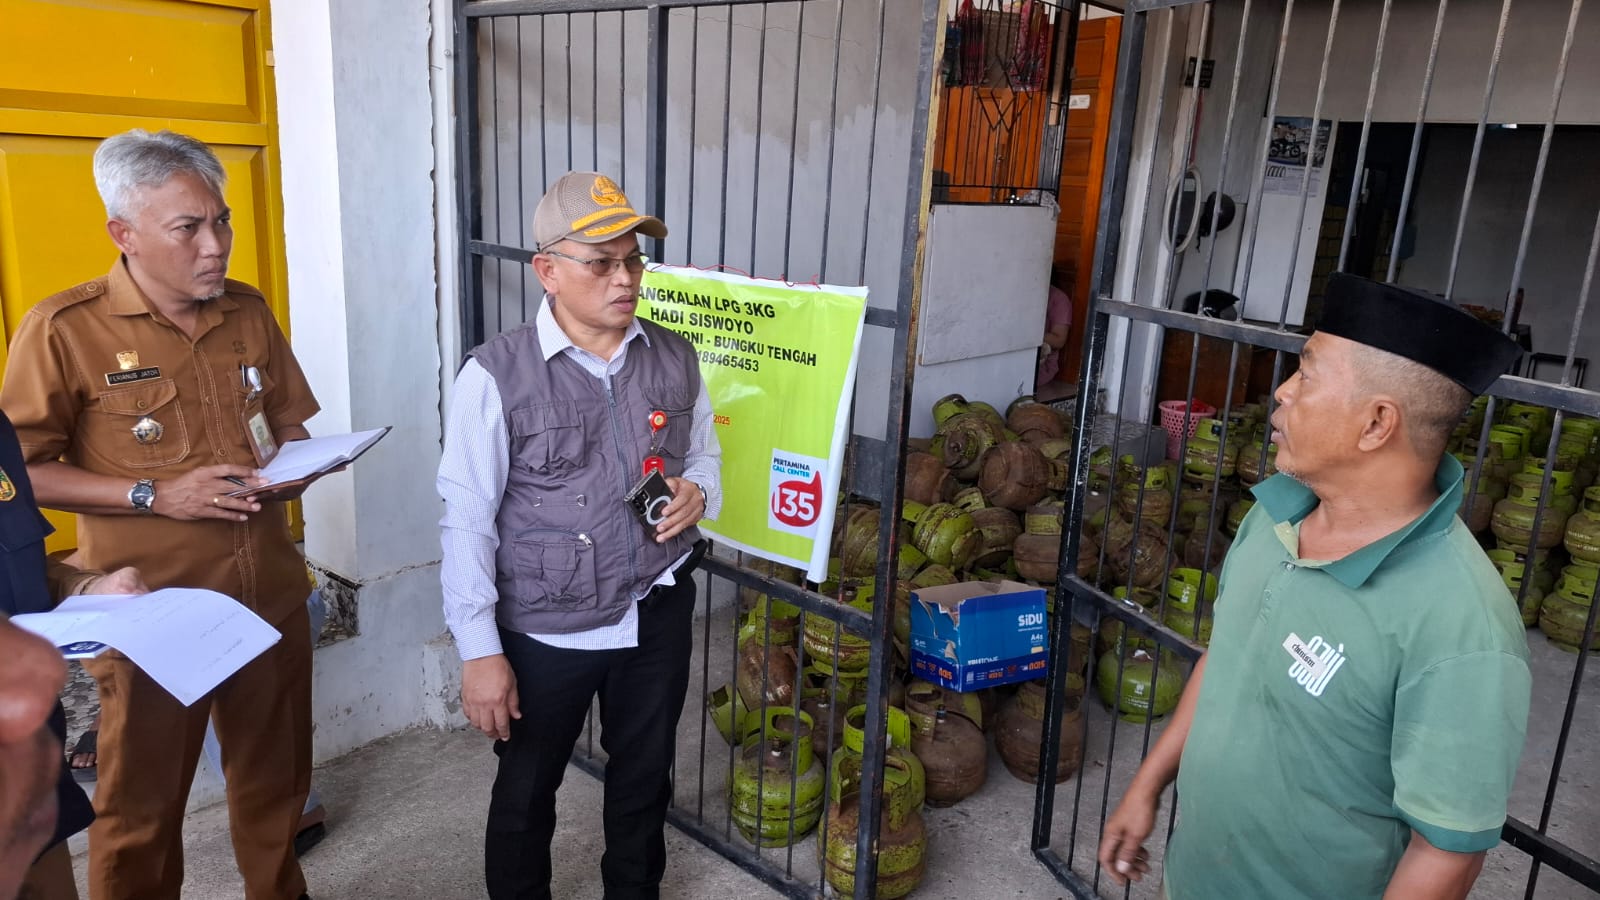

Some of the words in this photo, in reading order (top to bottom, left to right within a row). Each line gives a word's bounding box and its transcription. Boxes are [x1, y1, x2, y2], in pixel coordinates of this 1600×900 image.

[715, 298, 741, 314] LPG
[744, 301, 776, 319] 3KG
[650, 306, 684, 325] HADI
[689, 312, 754, 335] SISWOYO
[673, 329, 704, 345] ONI
[714, 335, 764, 356] BUNGKU
[768, 345, 817, 367] TENGAH
[713, 414, 730, 425] 2025
[772, 465, 786, 474] CALL
[787, 468, 810, 478] CENTER
[773, 457, 810, 471] PERTAMINA
[774, 486, 815, 521] 135
[1018, 612, 1043, 627] SiDU
